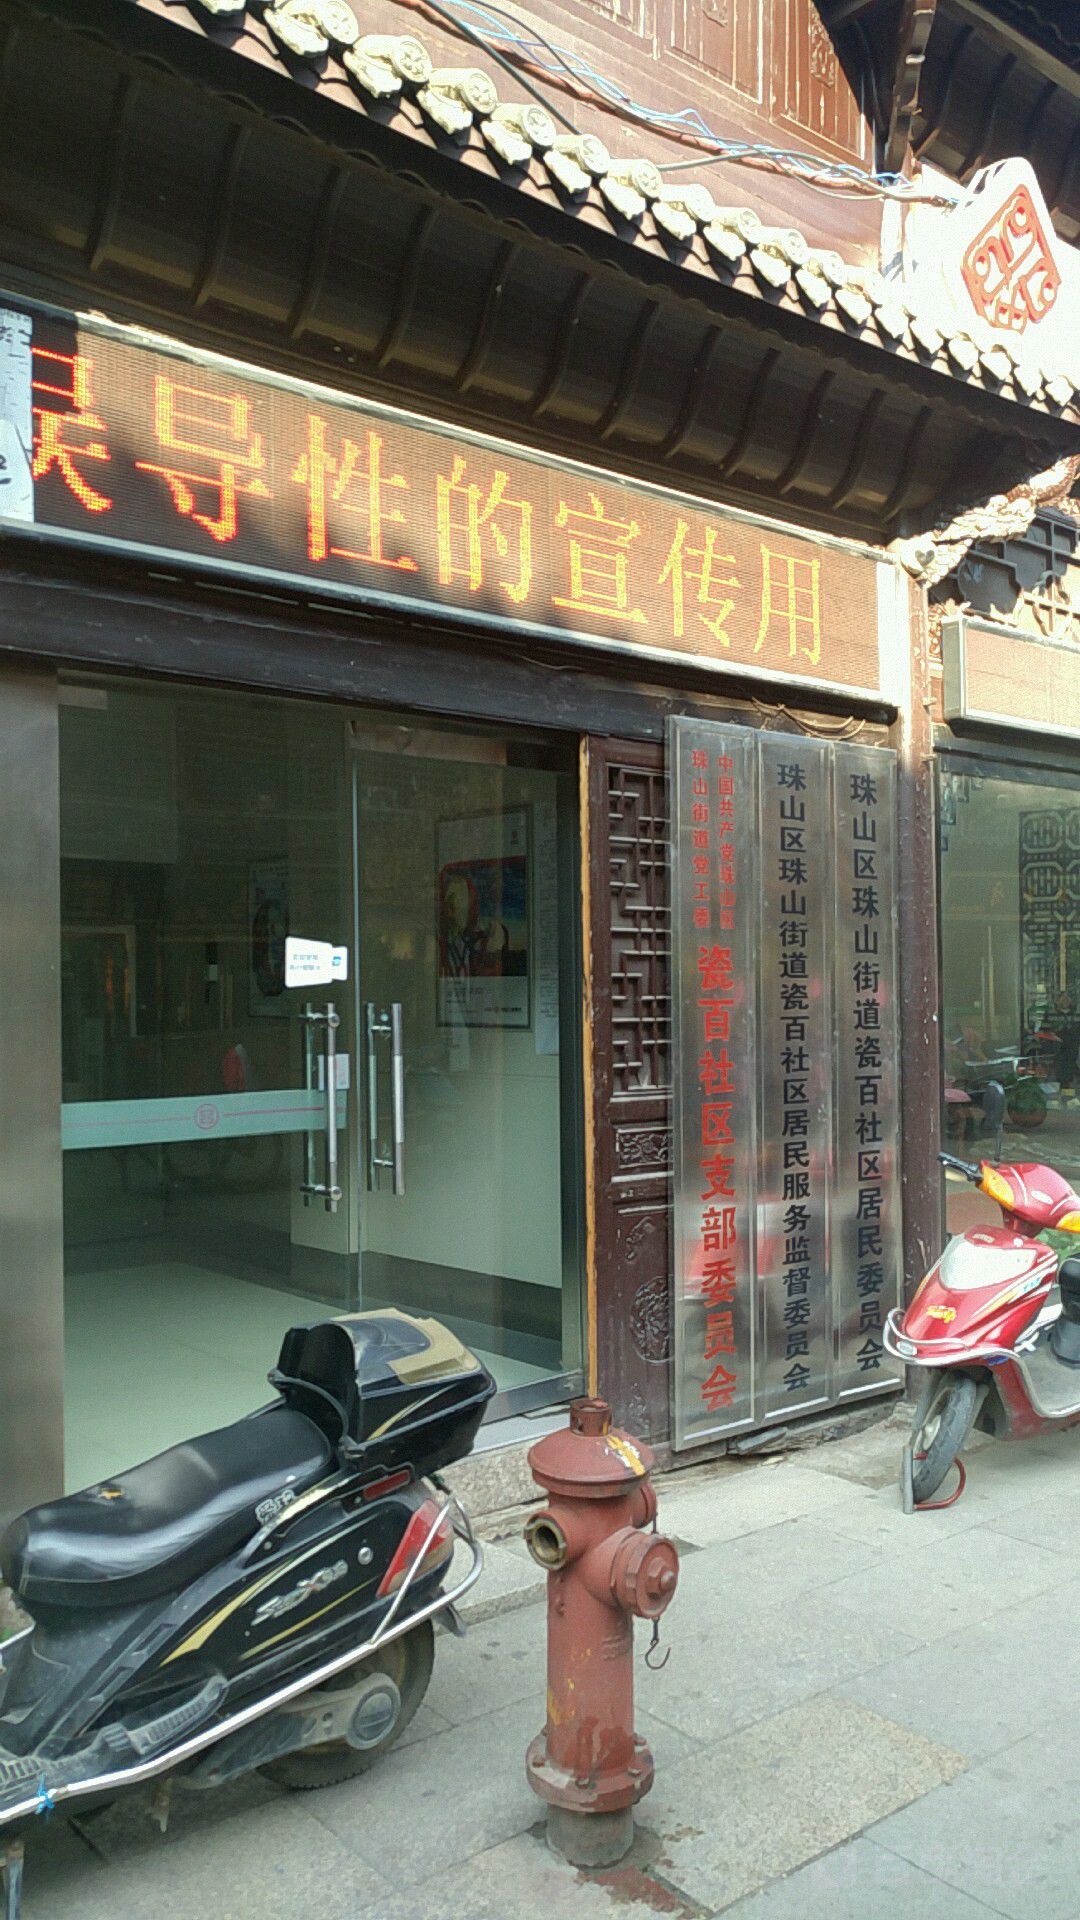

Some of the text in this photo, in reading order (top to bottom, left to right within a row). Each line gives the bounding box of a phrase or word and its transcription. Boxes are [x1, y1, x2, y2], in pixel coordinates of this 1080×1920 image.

[698, 945, 738, 1412] 瓷百社区支部委员会
[777, 763, 812, 1392] 珠山区珠山街道瓷百社区居民服务监督委员会
[850, 774, 884, 1371] 珠山区珠山街道瓷百社区居民委员会
